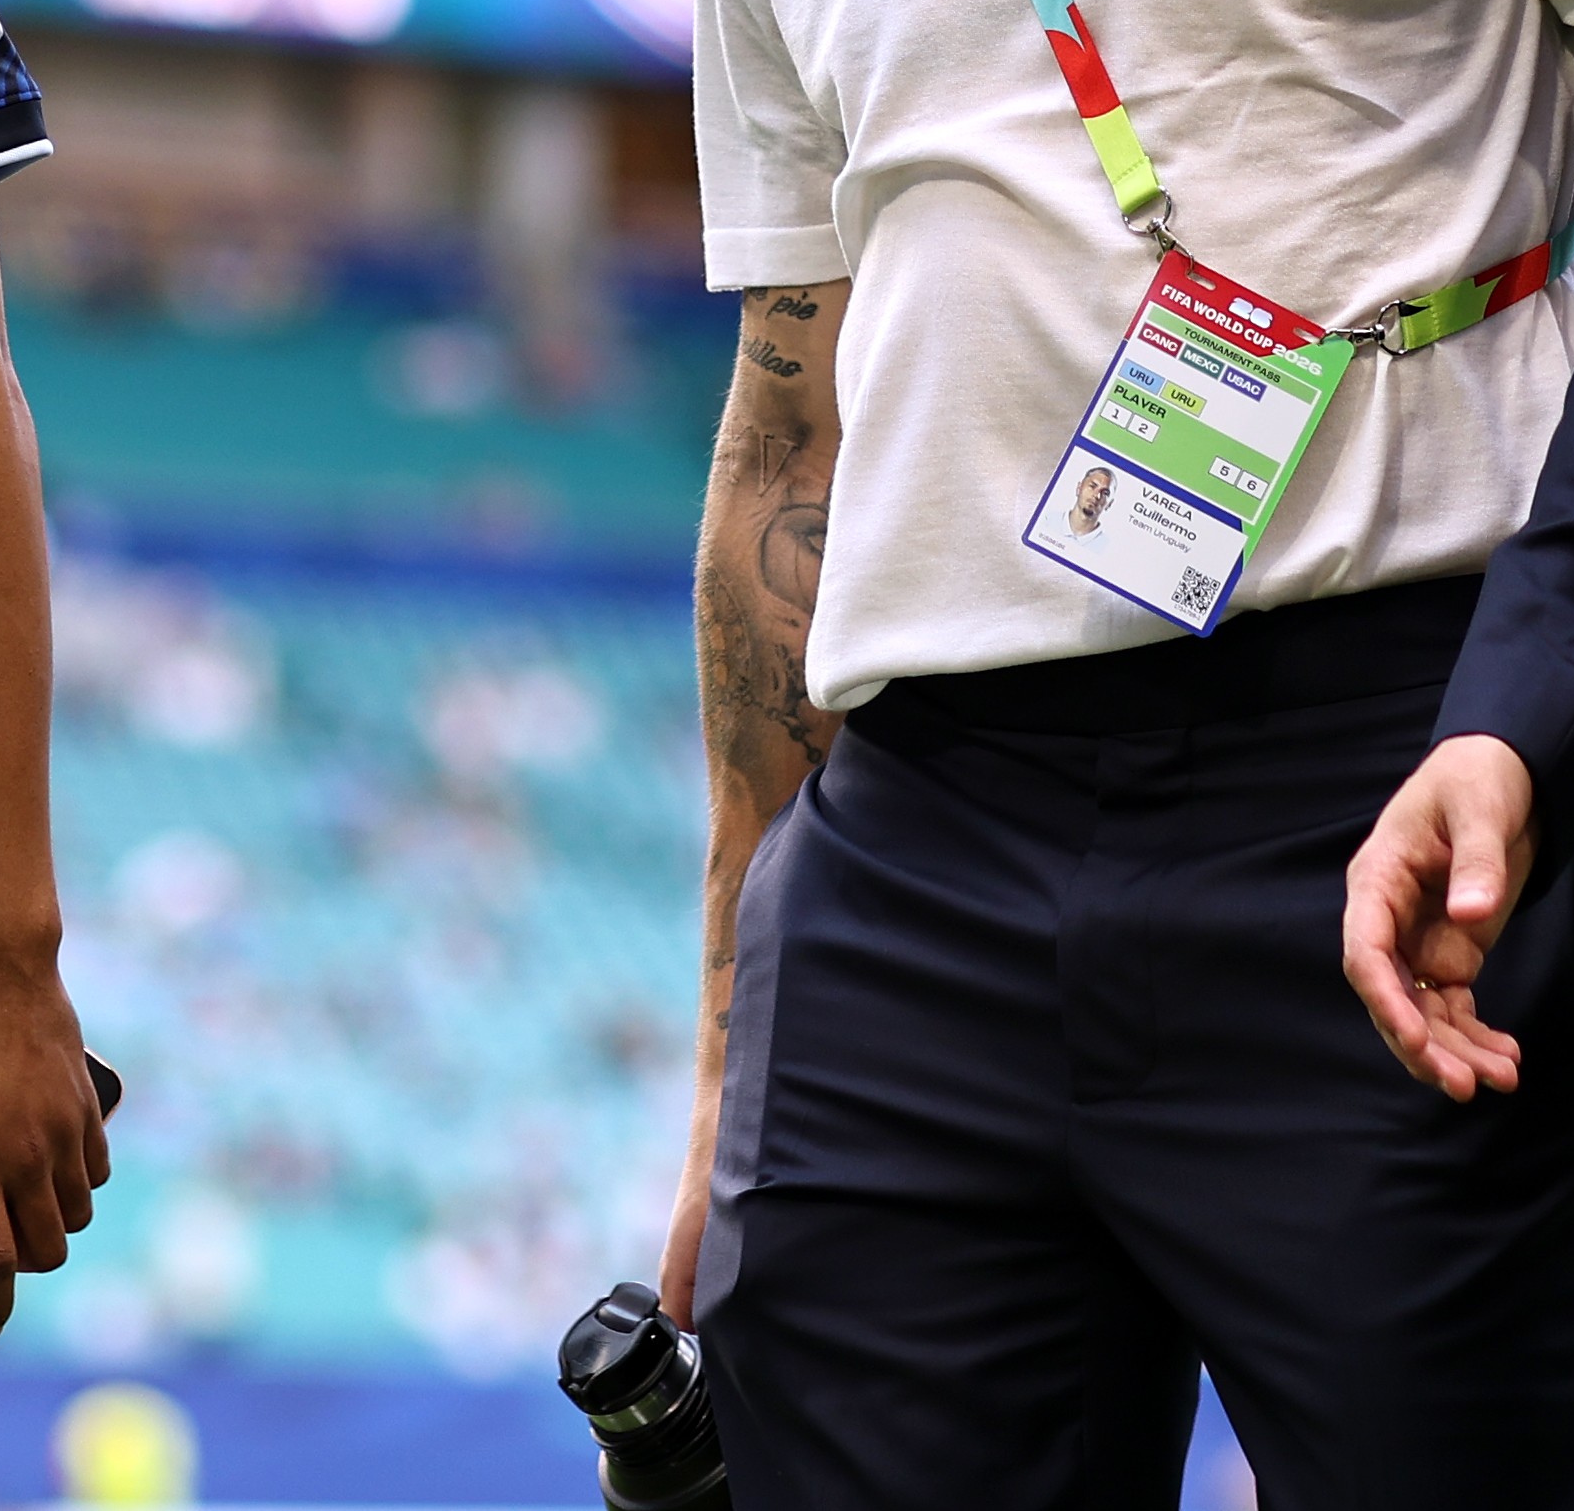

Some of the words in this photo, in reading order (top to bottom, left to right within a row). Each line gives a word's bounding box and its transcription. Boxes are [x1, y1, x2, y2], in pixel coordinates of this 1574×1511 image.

[1161, 284, 1190, 308] FIFA
[1193, 300, 1243, 334] WORLD
[1244, 326, 1273, 349] CUP
[1272, 343, 1323, 376] 2026
[1142, 328, 1178, 352] CANC
[1184, 349, 1220, 374] MEXC
[1226, 371, 1262, 395] USAC
[1184, 327, 1253, 368] TOURNAMENT
[1253, 364, 1281, 384] PASS
[1114, 385, 1167, 419] PLAYER
[1129, 367, 1155, 386] URU
[1170, 390, 1196, 408] URU
[1137, 423, 1149, 434] 2
[1219, 465, 1231, 477] 5
[1246, 480, 1258, 491] 6
[1133, 502, 1197, 541] Guillermo
[1142, 487, 1192, 521] VARELA
[1128, 515, 1153, 534] Team
[1153, 527, 1191, 553] Uruguay
